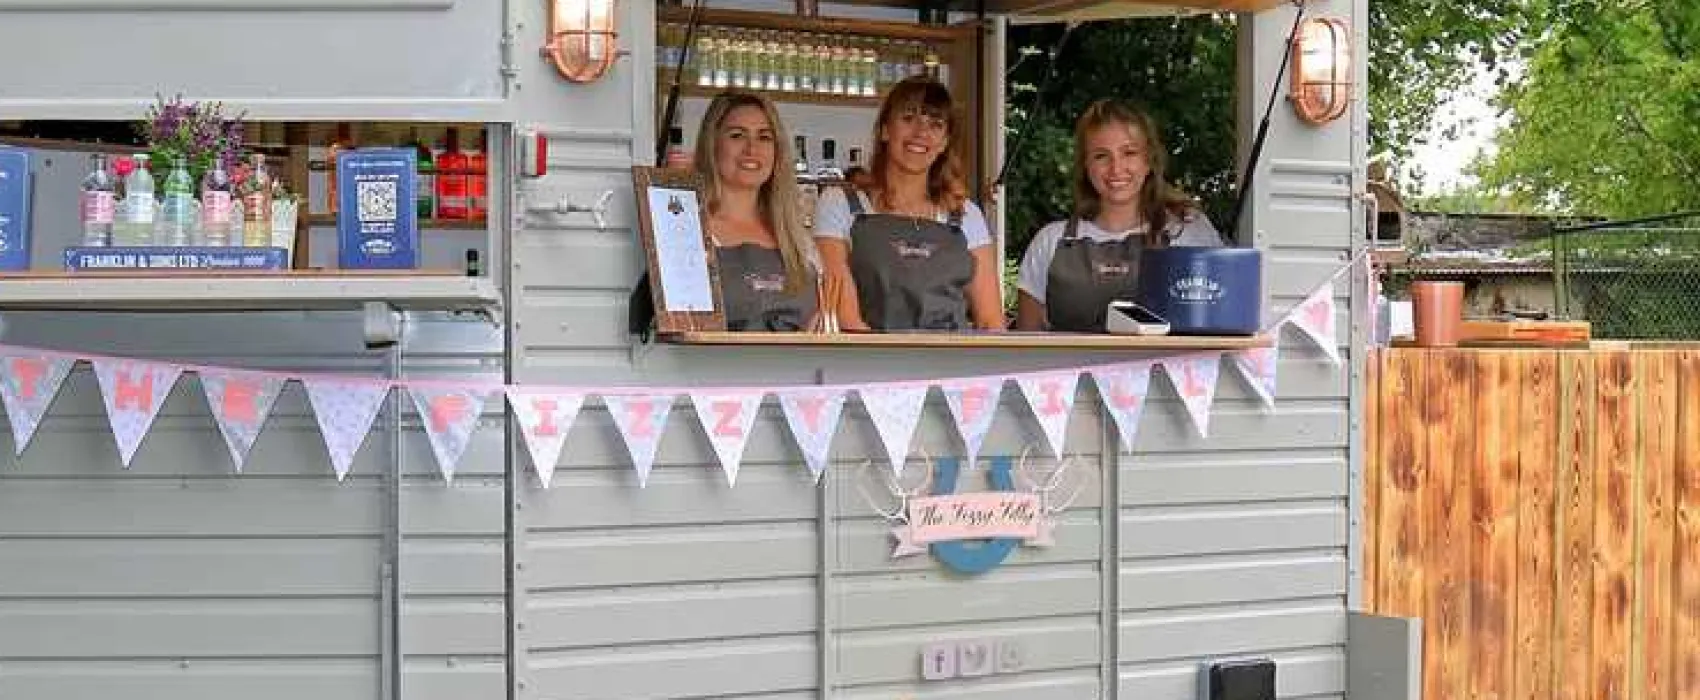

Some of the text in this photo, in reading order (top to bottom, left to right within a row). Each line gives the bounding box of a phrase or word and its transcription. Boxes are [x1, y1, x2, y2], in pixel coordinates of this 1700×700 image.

[12, 358, 257, 424] THE
[428, 394, 826, 437] FIZZY
[919, 503, 943, 526] The
